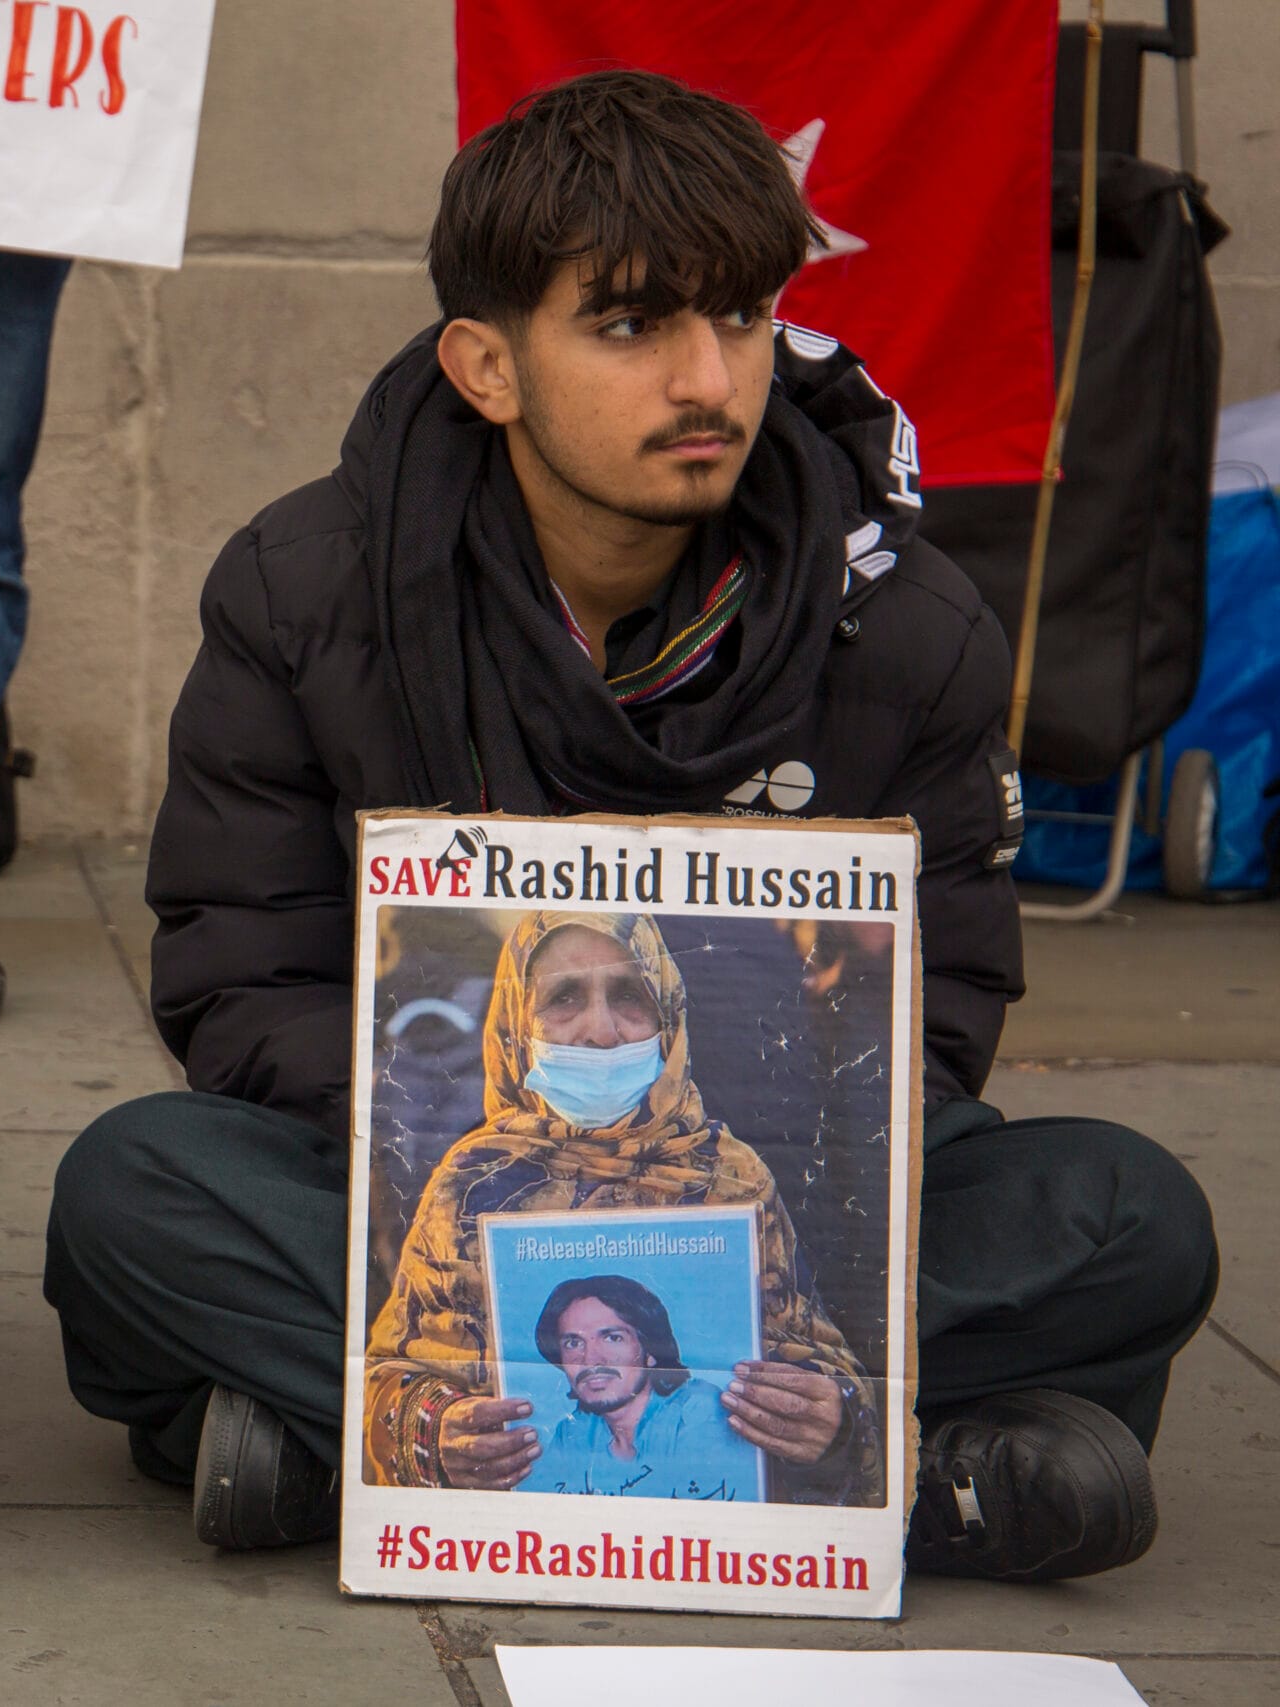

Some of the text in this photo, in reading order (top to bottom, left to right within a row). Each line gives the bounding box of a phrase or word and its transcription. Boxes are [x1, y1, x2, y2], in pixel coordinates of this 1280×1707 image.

[369, 844, 899, 911] SAVE Rashid Hussain
[517, 1231, 727, 1262] #ReleaseRashidHussain
[377, 1524, 870, 1591] #SaveRashidHussain
